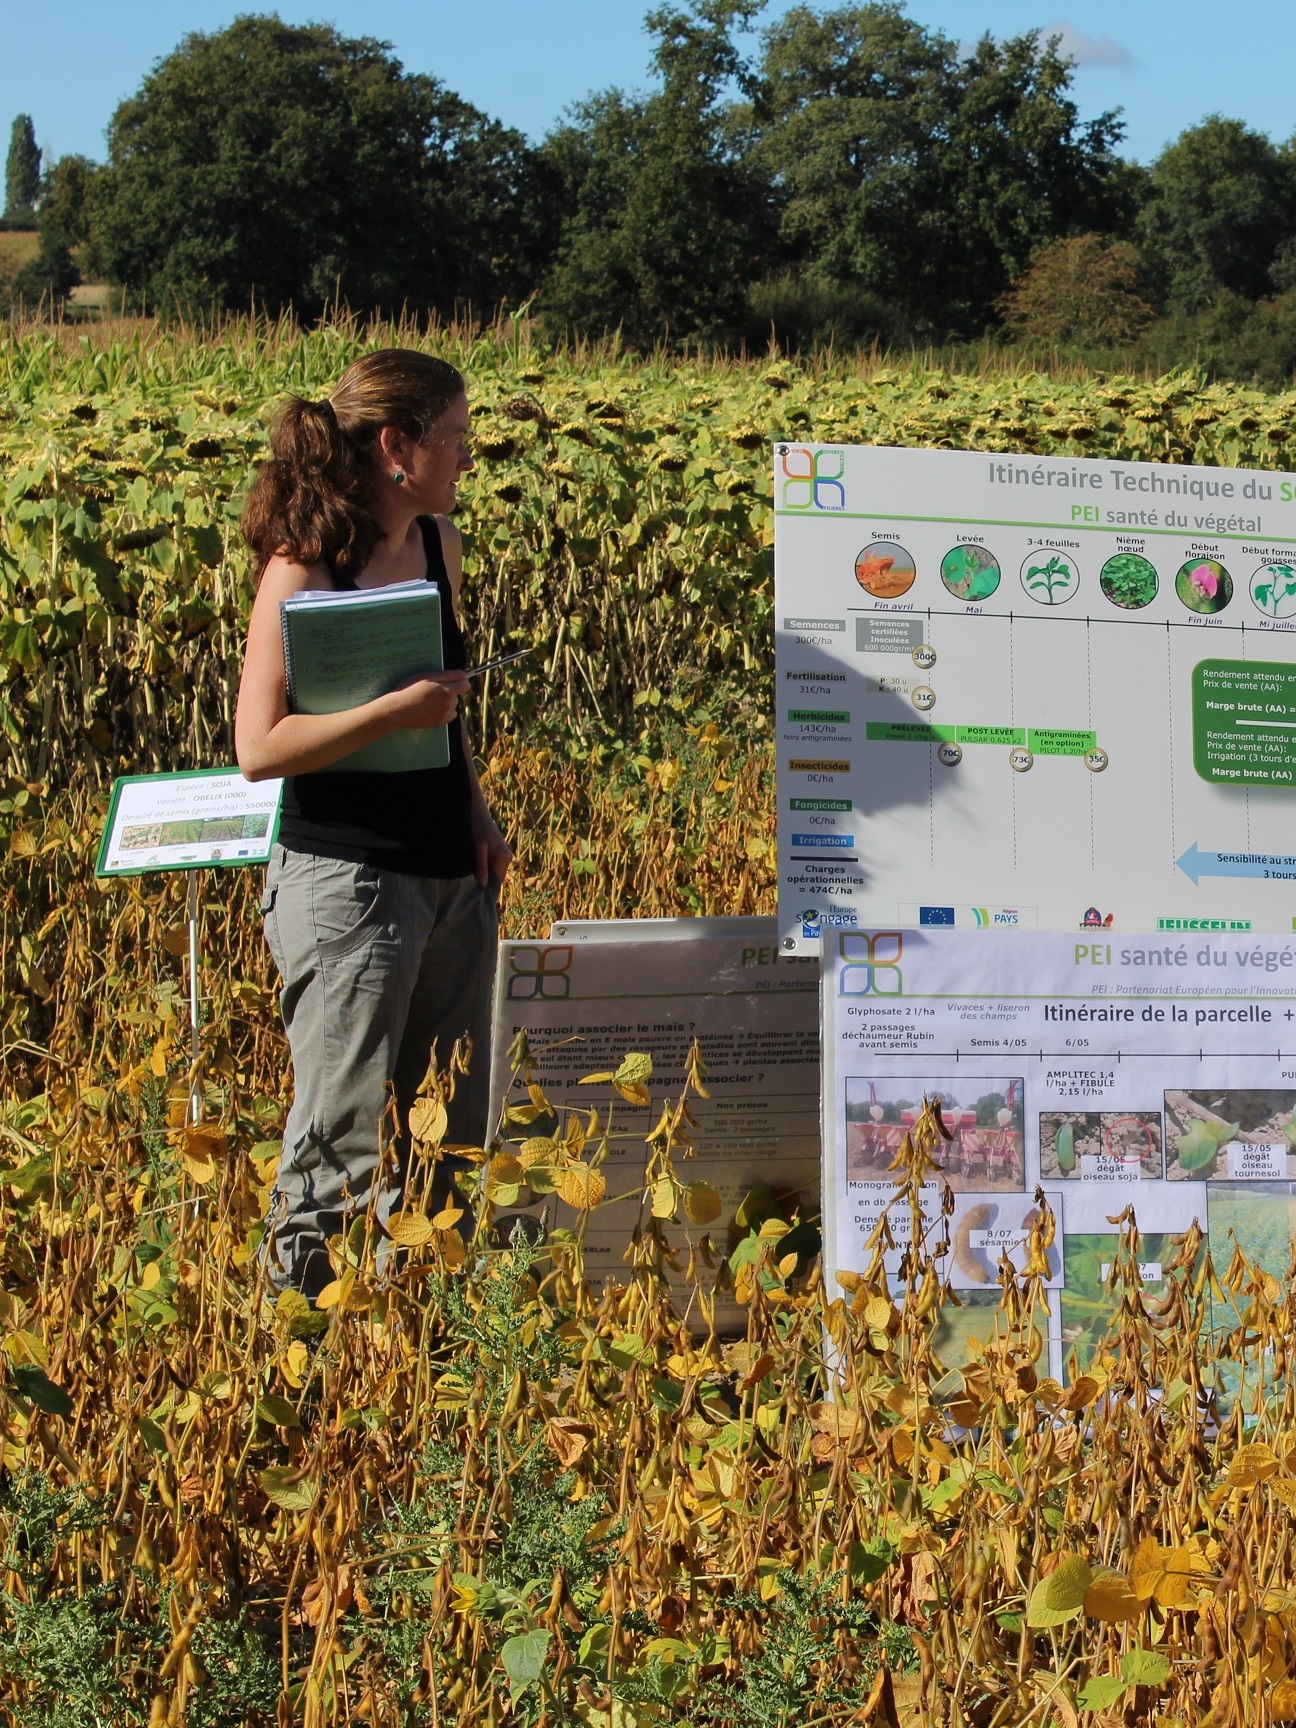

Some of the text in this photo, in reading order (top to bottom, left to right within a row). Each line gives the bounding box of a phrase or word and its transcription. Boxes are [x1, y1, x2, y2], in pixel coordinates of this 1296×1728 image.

[989, 463, 1103, 490] Itinéraire
[1110, 470, 1234, 501] Technique
[1243, 479, 1272, 501] du
[1071, 505, 1262, 534] PEI santé du végétal
[871, 532, 900, 540] Semis
[956, 534, 984, 543] Levée
[1027, 539, 1080, 548] 3-4 feuilles
[1116, 537, 1145, 546] Nième
[1118, 545, 1143, 553] nœud
[1192, 543, 1218, 552] Début
[1242, 546, 1269, 555] Début
[1185, 551, 1225, 561] floraison
[1261, 556, 1296, 565] gousses
[874, 602, 914, 611] Fin avril
[966, 606, 982, 614] Mai
[869, 620, 909, 628] Semences
[1188, 616, 1222, 625] Fin juin
[790, 621, 840, 630] Semences
[871, 628, 908, 636] certifiées
[870, 636, 909, 644] Inoculées
[787, 672, 845, 683] Fertilisation
[793, 712, 845, 721] Herbicides
[990, 727, 1014, 736] LEVÉE
[790, 761, 849, 771] Insecticides
[807, 774, 833, 783] 0€/ha
[193, 794, 222, 802] OBELIX
[225, 792, 246, 800] (000)
[795, 801, 847, 811] Fongicides
[809, 816, 835, 826] 0€/ha
[799, 837, 847, 845] Irrigation
[1217, 853, 1267, 866] Sensibilité
[1270, 857, 1281, 866] au
[805, 865, 845, 874] Charges
[1264, 870, 1269, 878] 3
[1272, 871, 1296, 879] tours
[787, 875, 864, 885] opérationnelles
[995, 914, 1018, 923] PAYS
[1074, 945, 1111, 965] PEI
[1121, 945, 1187, 967] santé
[1196, 945, 1228, 967] du
[847, 1007, 902, 1017] Glyphosate
[915, 1007, 935, 1015] l/ha
[1045, 1005, 1134, 1021] Itinéraire
[1141, 1005, 1165, 1021] de
[1171, 1006, 1187, 1022] la
[1195, 1006, 1271, 1026] parcelle
[1284, 1010, 1294, 1021] +
[870, 1023, 915, 1033] passages
[842, 1031, 934, 1040] déchaumeur Rubin
[889, 1040, 918, 1048] semis
[1003, 1038, 1027, 1047] 4/05
[1066, 1039, 1089, 1047] 6/05
[1242, 1144, 1271, 1152] 15/05
[1243, 1152, 1271, 1162] dégât
[1235, 1169, 1281, 1177] tournesol
[980, 1238, 1019, 1247] sésamie
